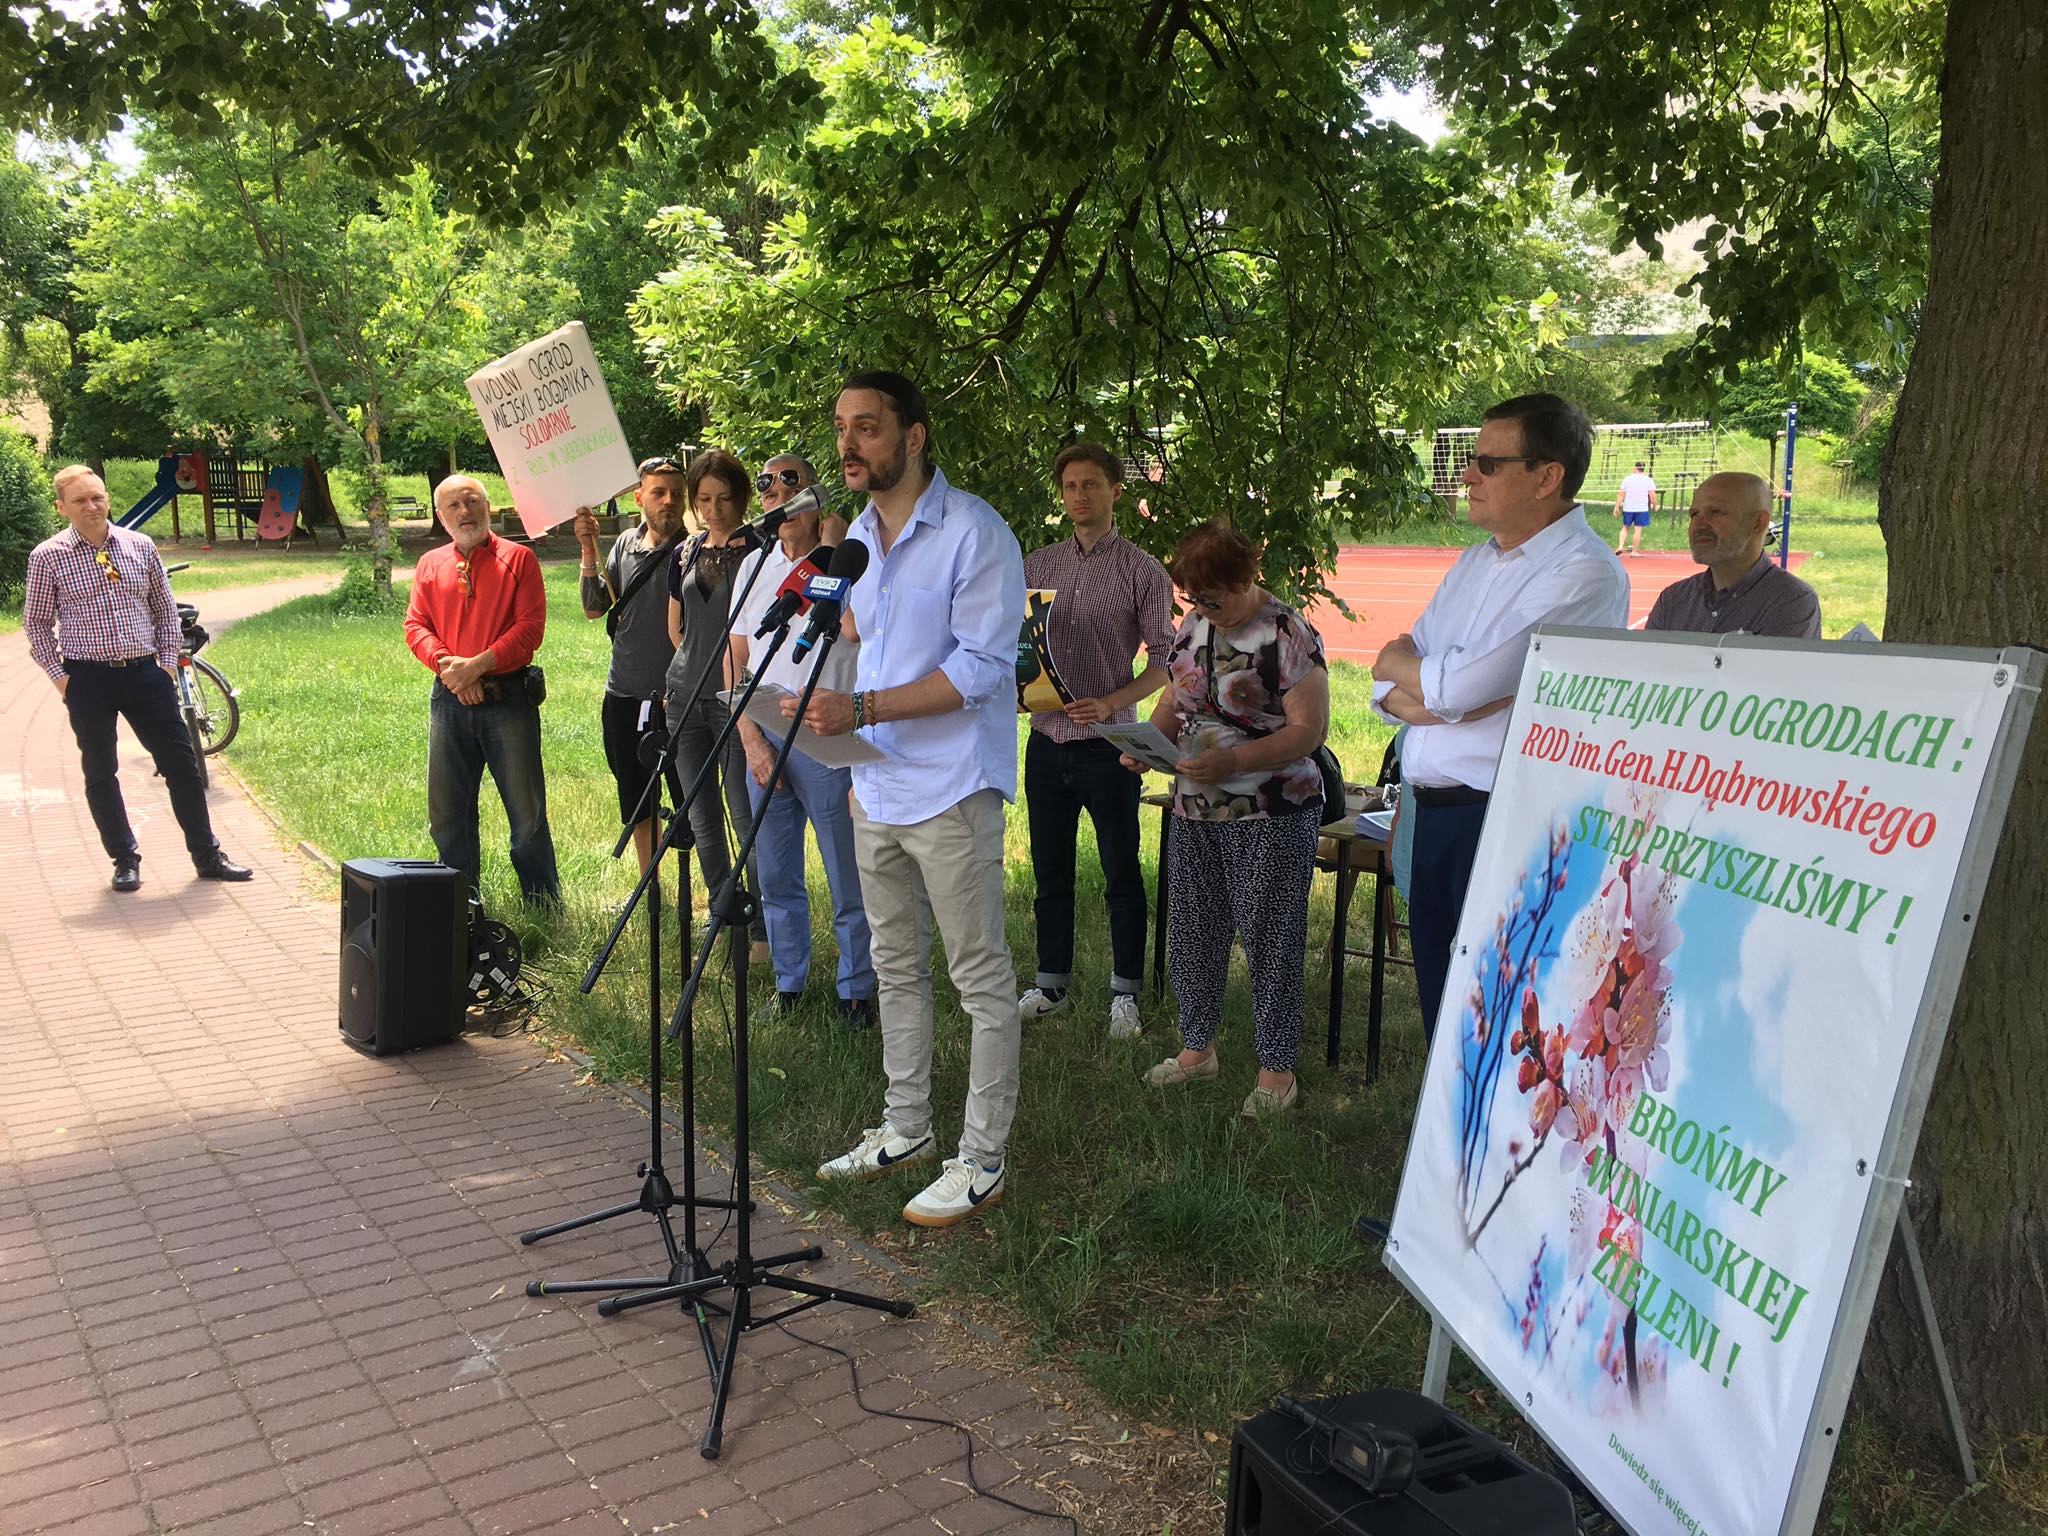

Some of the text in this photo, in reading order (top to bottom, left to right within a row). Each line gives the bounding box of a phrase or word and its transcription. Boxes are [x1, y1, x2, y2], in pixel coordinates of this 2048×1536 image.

[476, 341, 573, 405] WOLNY OGRÓD
[491, 366, 595, 432] MIEJSKI BOGDANKA
[519, 404, 576, 449] SOLIDARNIE
[1521, 723, 1570, 762] ROD
[1534, 670, 1974, 773] PAMIĘTAJMY O OGRODACH :
[1573, 805, 1913, 944] STĄD PRZYSZLIŚMY !
[1628, 1092, 1788, 1217] BROŃMY
[1587, 1145, 1810, 1343] WINIARSKIEJ
[1591, 1238, 1742, 1389] ZIELENI !
[1608, 1432, 1701, 1536] Dowiedz się więcej
